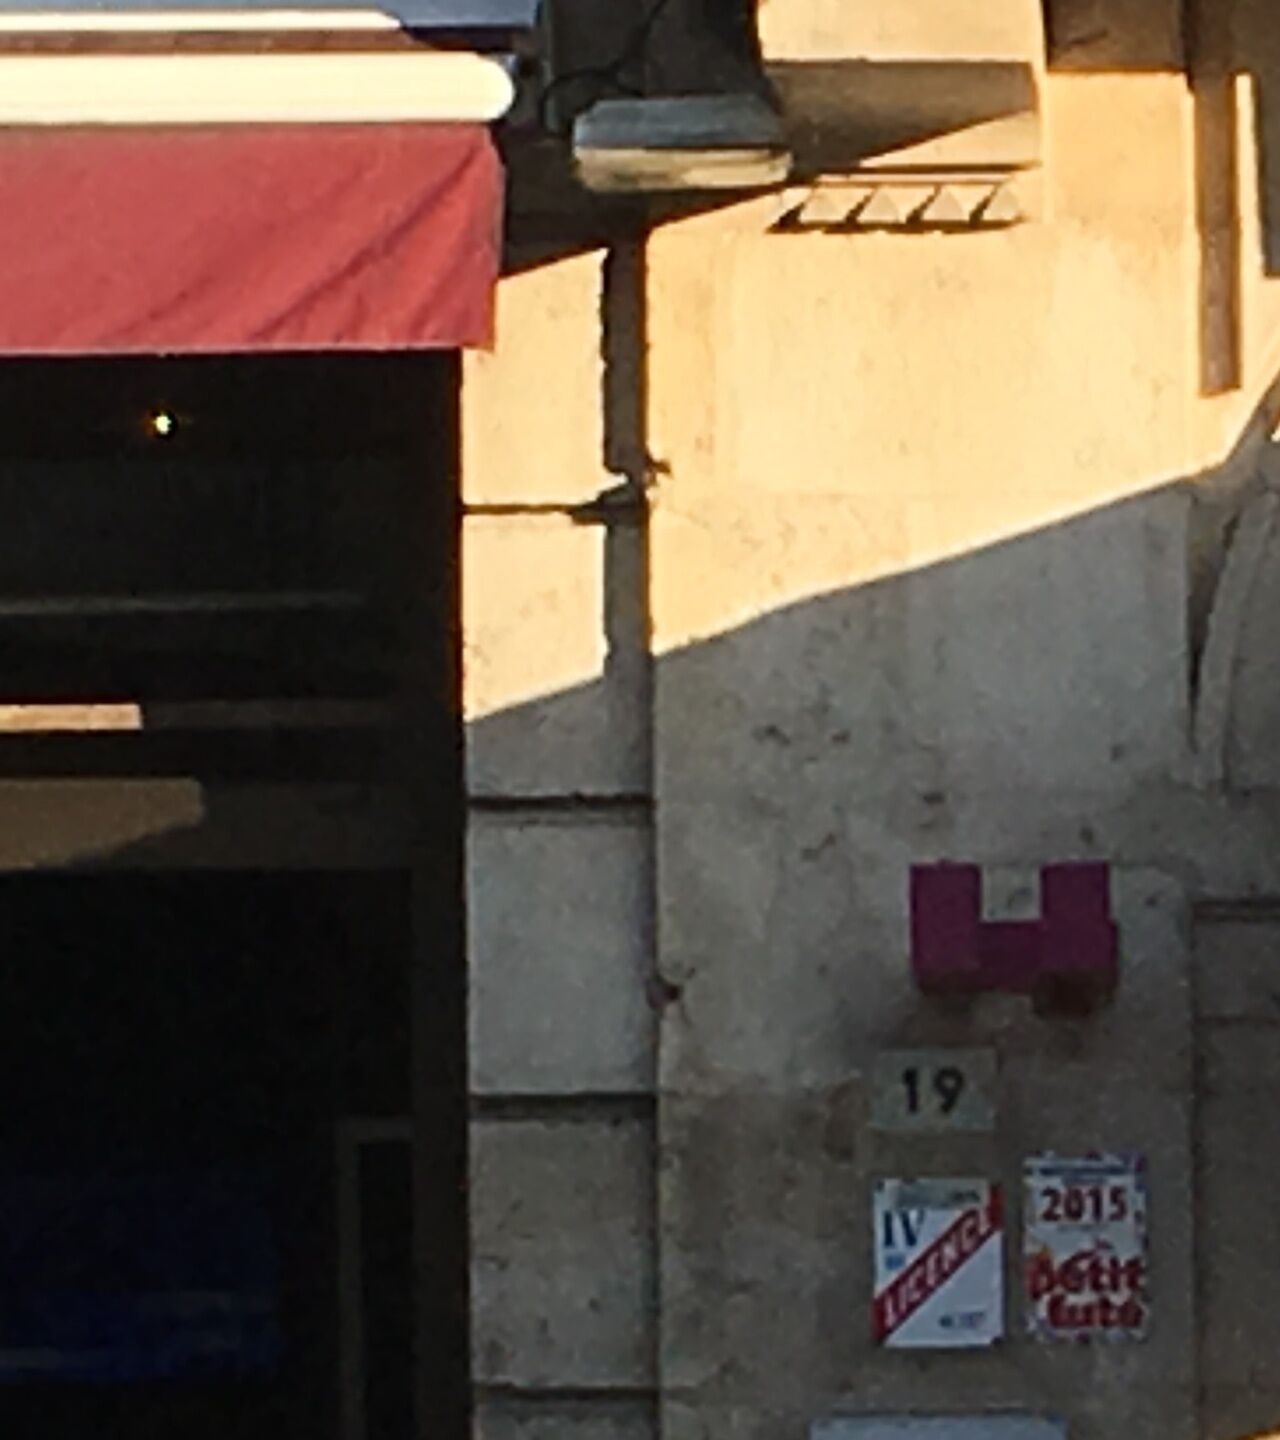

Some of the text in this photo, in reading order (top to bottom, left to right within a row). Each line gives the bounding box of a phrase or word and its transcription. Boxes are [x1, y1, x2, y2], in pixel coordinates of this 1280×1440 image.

[901, 1067, 966, 1114] 19
[1040, 1185, 1129, 1222] 2015
[883, 1208, 924, 1247] IV
